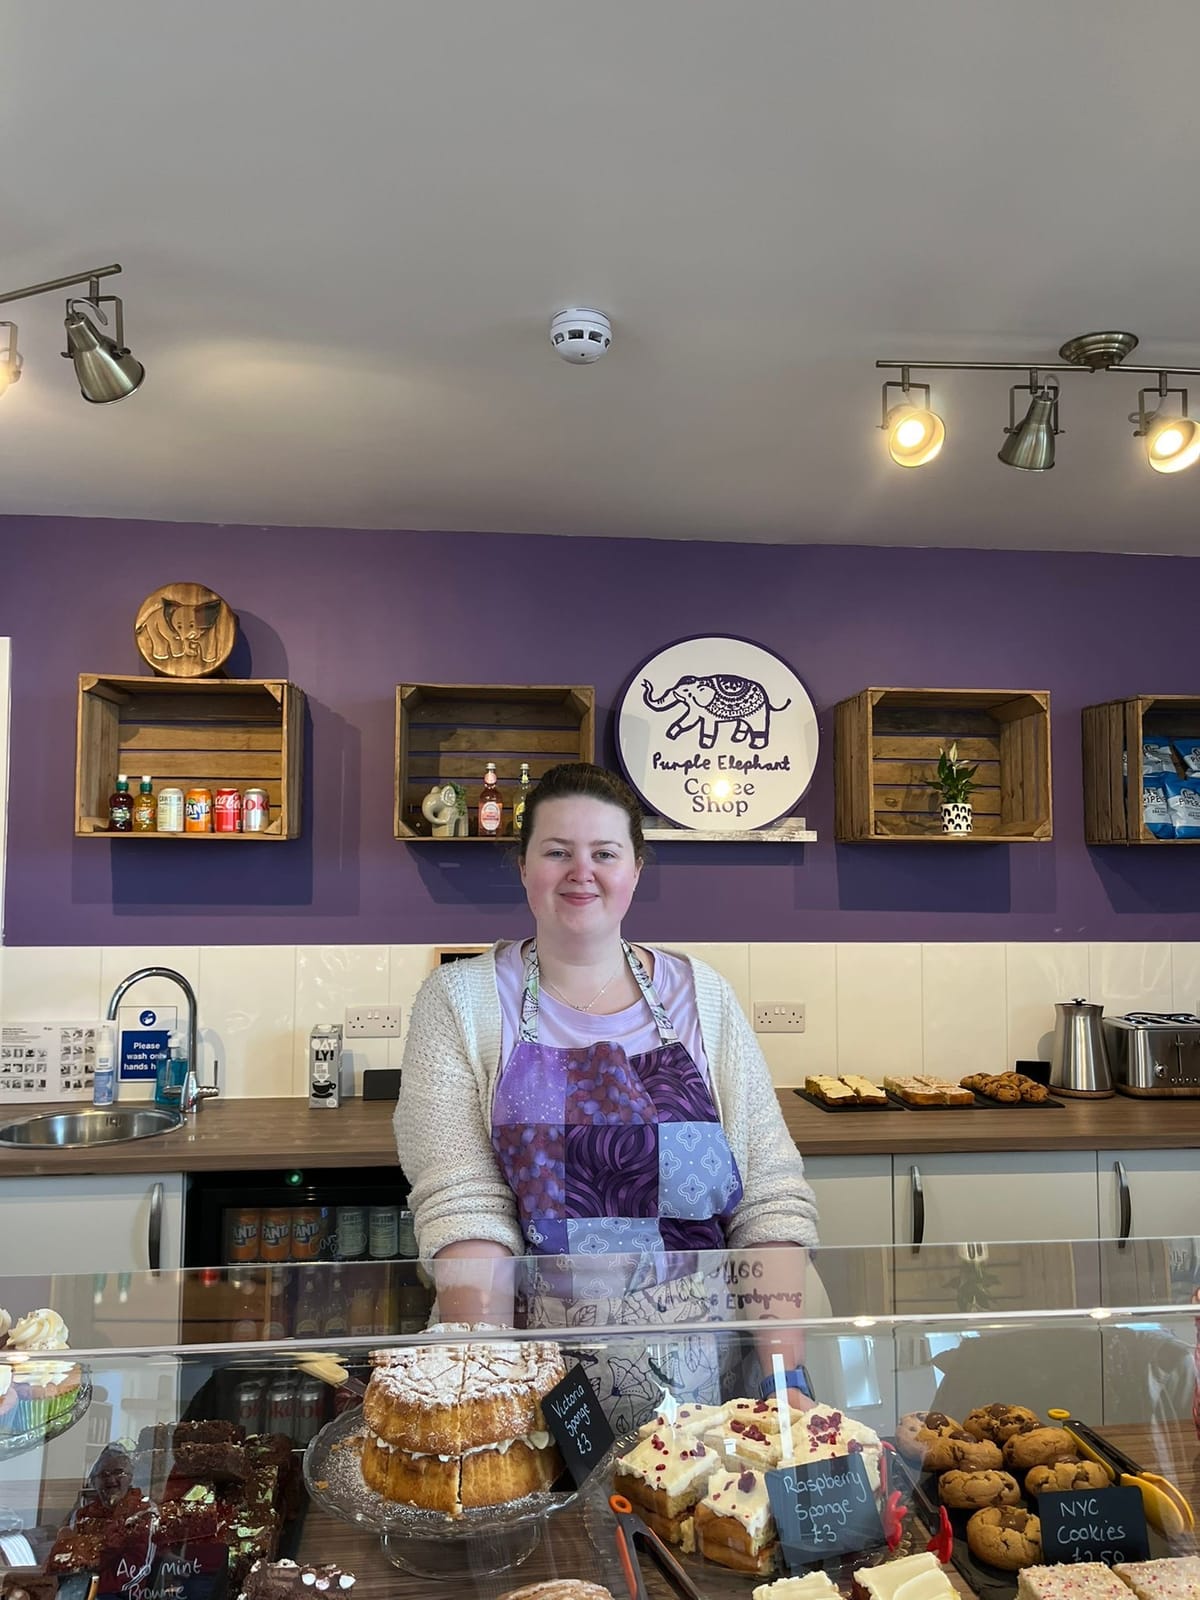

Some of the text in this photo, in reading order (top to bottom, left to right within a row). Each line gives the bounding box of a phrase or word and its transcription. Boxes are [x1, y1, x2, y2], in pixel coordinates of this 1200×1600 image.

[652, 752, 791, 775] Purple Elephant
[684, 778, 755, 796] Coee
[185, 801, 210, 816] FANTA
[692, 796, 749, 817] Shop
[126, 1052, 148, 1060] wash
[133, 1042, 161, 1050] Please
[315, 1050, 334, 1061] LY!
[123, 1063, 149, 1071] hands
[551, 1384, 585, 1418] Victoria
[564, 1402, 591, 1437] Sponge
[577, 1433, 592, 1455] £3
[783, 1471, 867, 1503] Raspberry
[795, 1498, 853, 1525] Sponge
[1060, 1498, 1099, 1517] NYC
[811, 1523, 837, 1544] £3
[1057, 1519, 1126, 1544] Cookies
